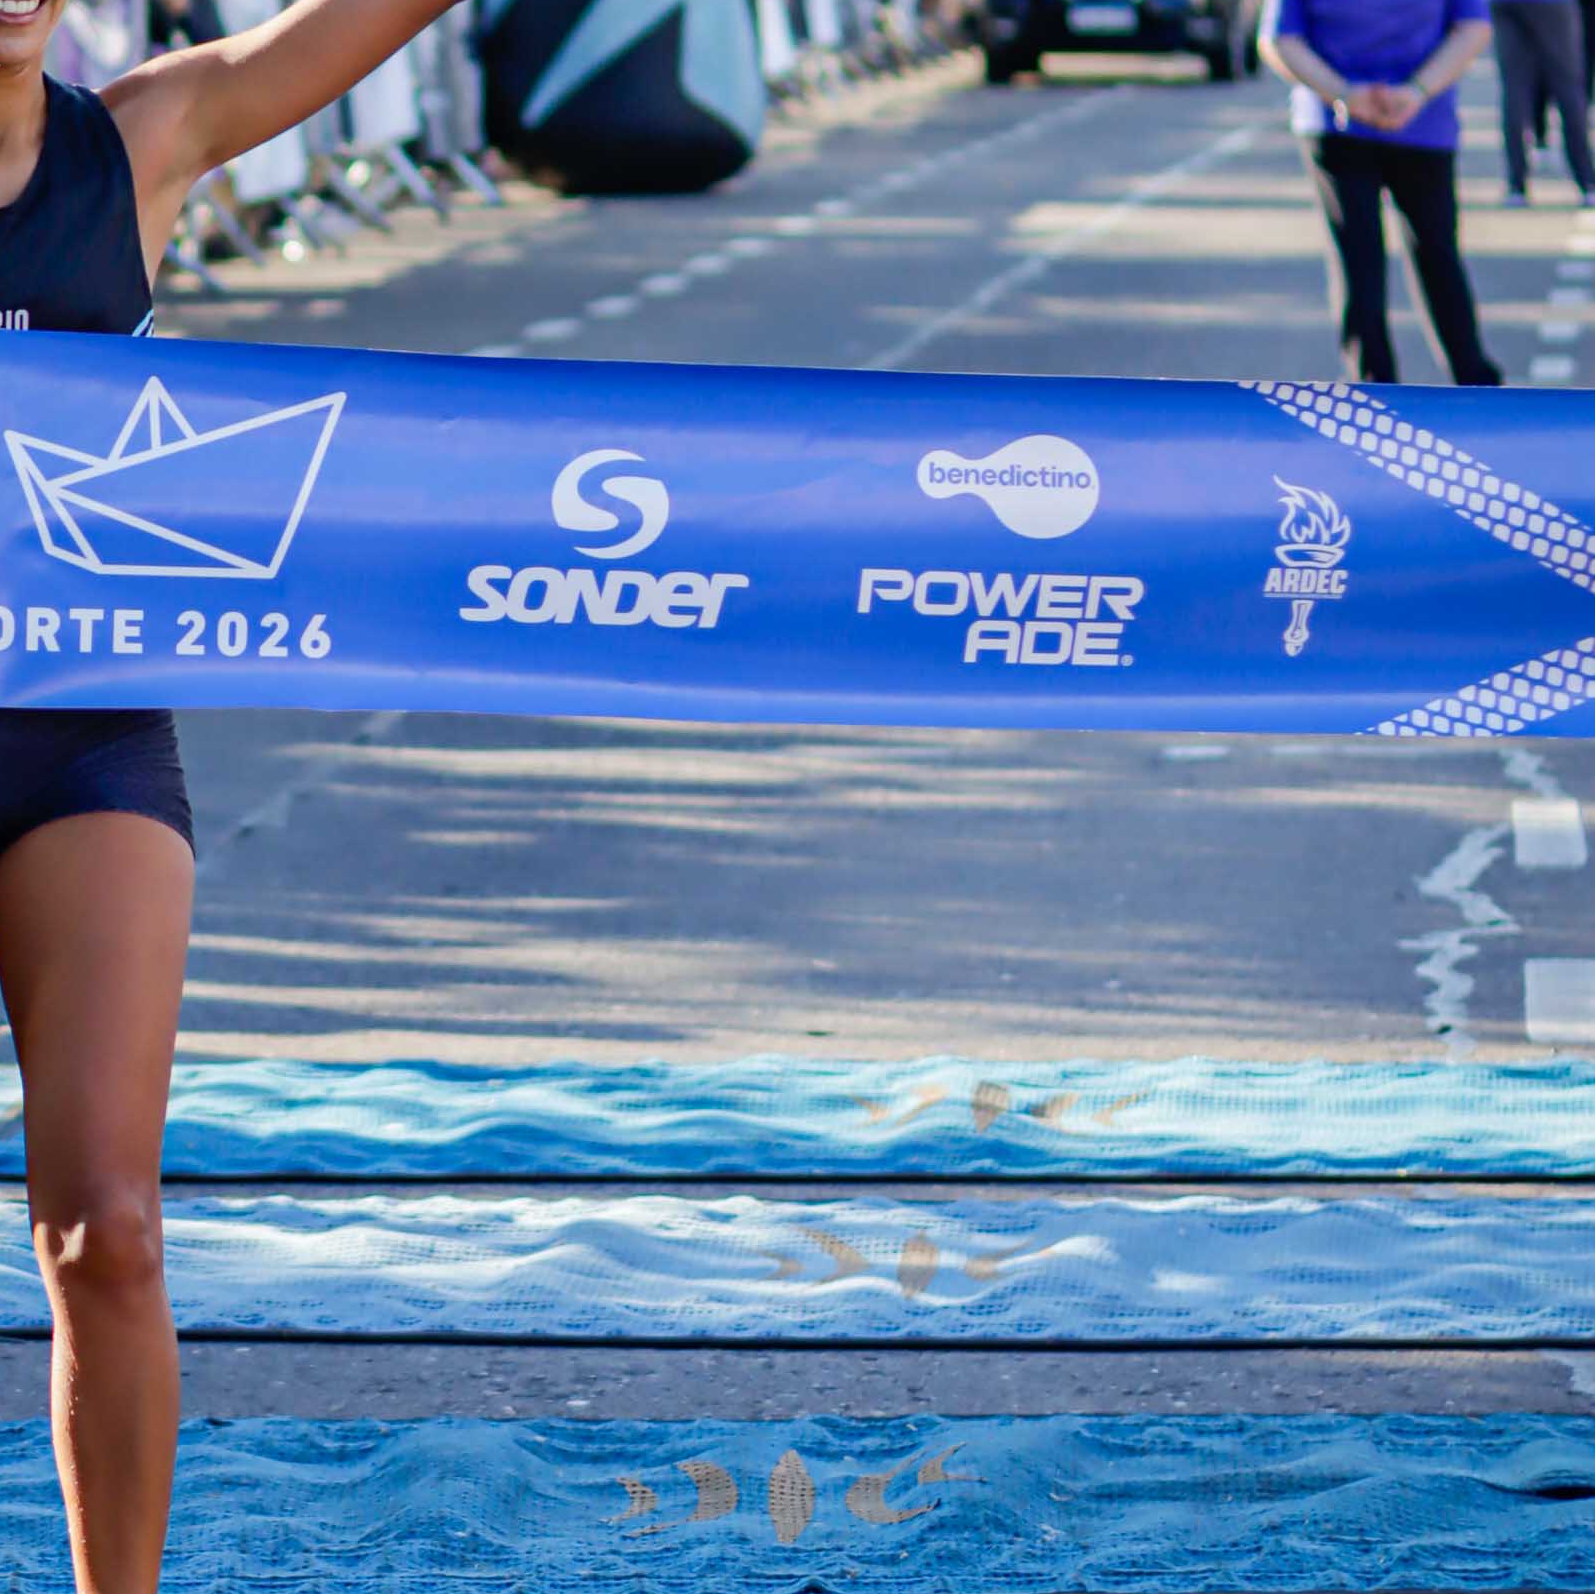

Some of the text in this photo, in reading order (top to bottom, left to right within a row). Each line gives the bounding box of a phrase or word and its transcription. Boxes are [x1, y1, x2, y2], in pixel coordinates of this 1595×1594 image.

[928, 461, 1092, 489] benedictino
[857, 568, 1145, 620] POWER
[1263, 567, 1349, 594] ARDEC
[175, 610, 332, 659] 2026
